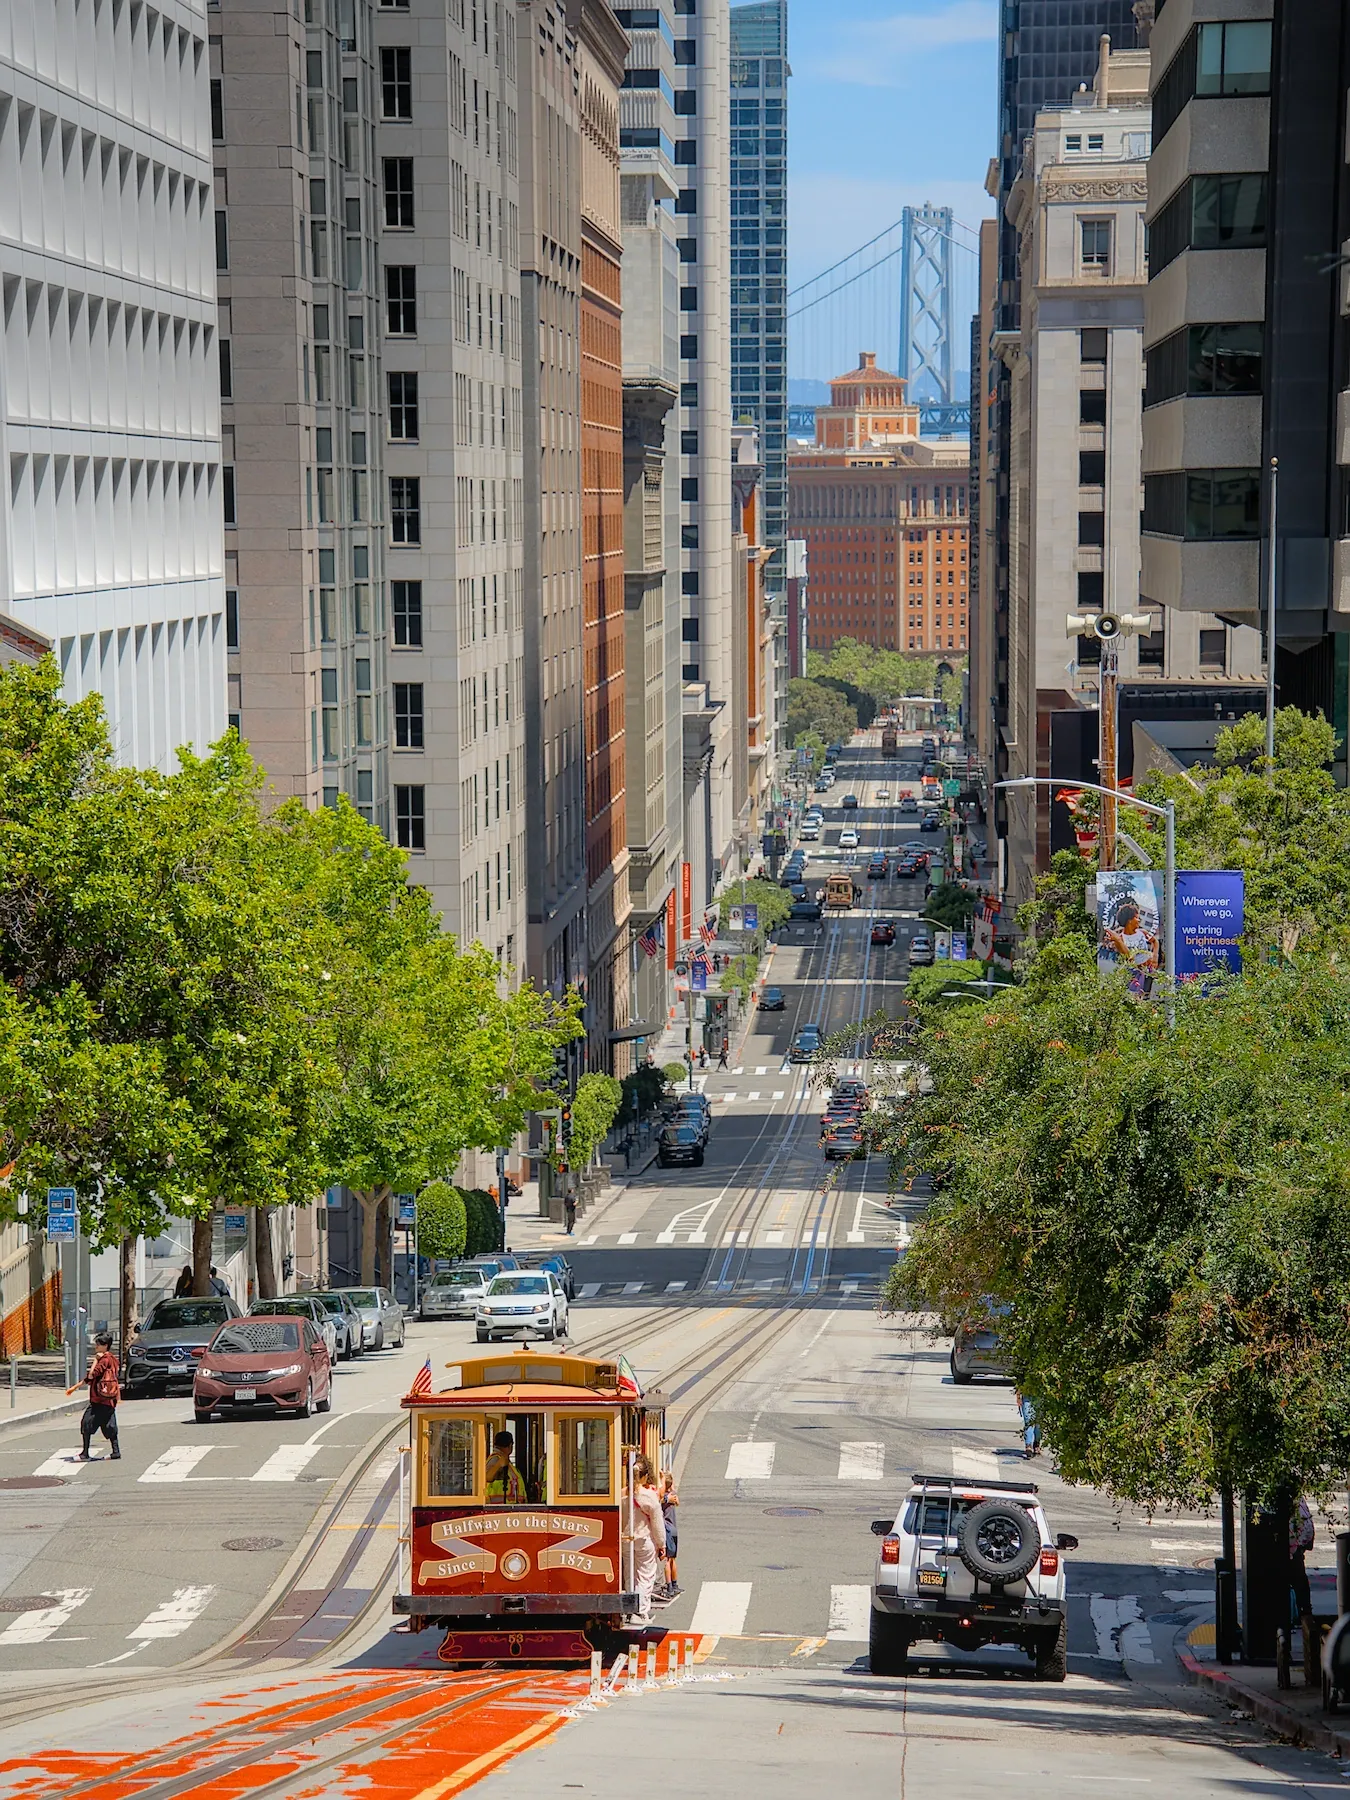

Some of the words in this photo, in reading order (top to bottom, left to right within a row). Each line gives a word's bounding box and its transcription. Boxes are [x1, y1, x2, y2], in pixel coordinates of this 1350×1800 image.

[1182, 896, 1230, 906] Wherever
[1203, 909, 1218, 917] we
[1219, 909, 1234, 919] go,
[1198, 925, 1222, 936] bring
[1186, 936, 1236, 947] brightness
[1192, 947, 1214, 956] with
[1215, 948, 1229, 956] us.
[442, 1518, 500, 1536] Halfway
[506, 1516, 520, 1528] to
[525, 1516, 548, 1528] the
[552, 1517, 590, 1534] Stars
[560, 1553, 593, 1571] 1873
[438, 1560, 476, 1576] Since
[509, 1634, 524, 1643] 53
